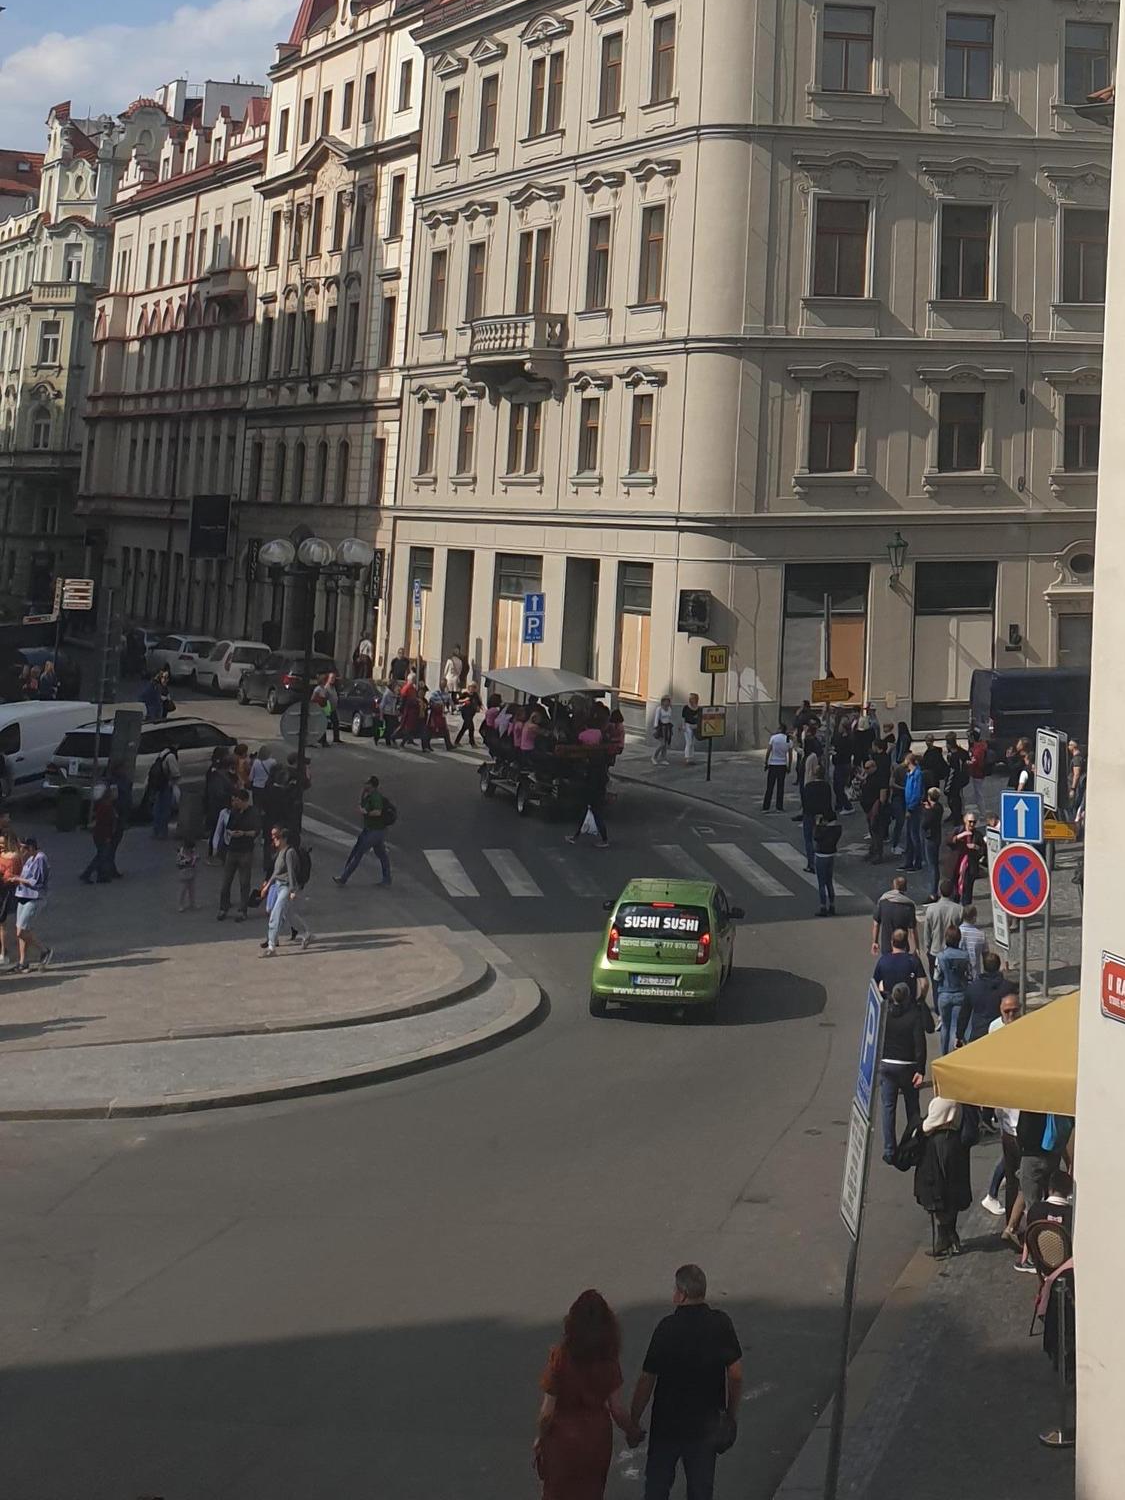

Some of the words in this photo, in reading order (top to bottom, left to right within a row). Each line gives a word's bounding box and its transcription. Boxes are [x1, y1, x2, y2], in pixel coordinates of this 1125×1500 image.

[527, 617, 540, 634] P
[624, 915, 660, 929] SUSHI
[663, 917, 700, 932] SUSHI
[1107, 973, 1114, 991] U
[613, 987, 695, 997] www.sushisushi.cz
[862, 1001, 876, 1065] P
